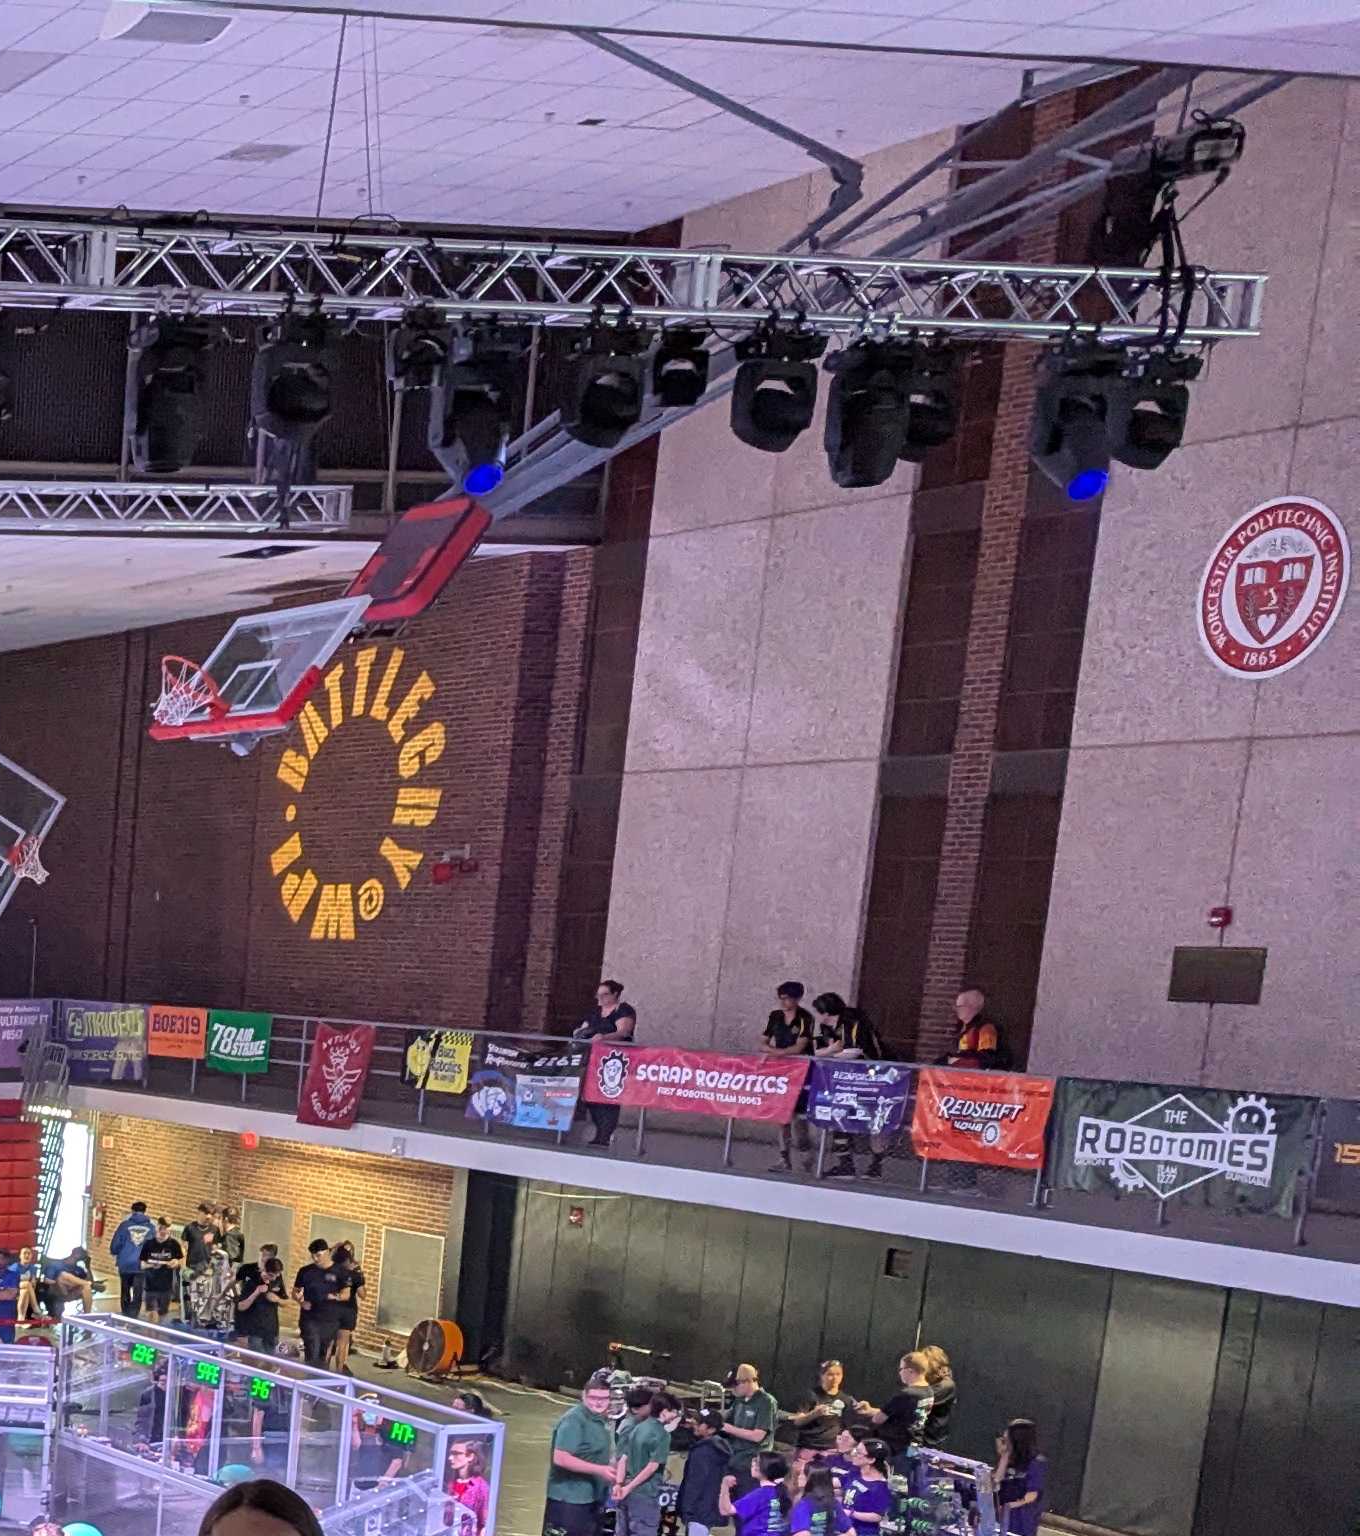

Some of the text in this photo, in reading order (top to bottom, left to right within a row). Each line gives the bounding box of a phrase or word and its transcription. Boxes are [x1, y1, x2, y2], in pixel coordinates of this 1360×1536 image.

[1205, 508, 1340, 649] WORCESTER POLYTECHNIC INSTITUTE
[1242, 648, 1278, 666] 1865
[210, 1022, 236, 1054] 78
[237, 1027, 254, 1041] AIR
[231, 1039, 267, 1056] STRIKE
[636, 1064, 790, 1095] SCRAP ROBOTICS
[657, 1086, 674, 1096] FIRST
[676, 1088, 715, 1101] ROBOTICS
[716, 1093, 737, 1104] TEAM
[938, 1095, 1027, 1121] REDSHIFT
[1164, 1109, 1188, 1125] THE
[1079, 1121, 1271, 1172] ROBOTOMIES
[1157, 1165, 1178, 1175] TEAM
